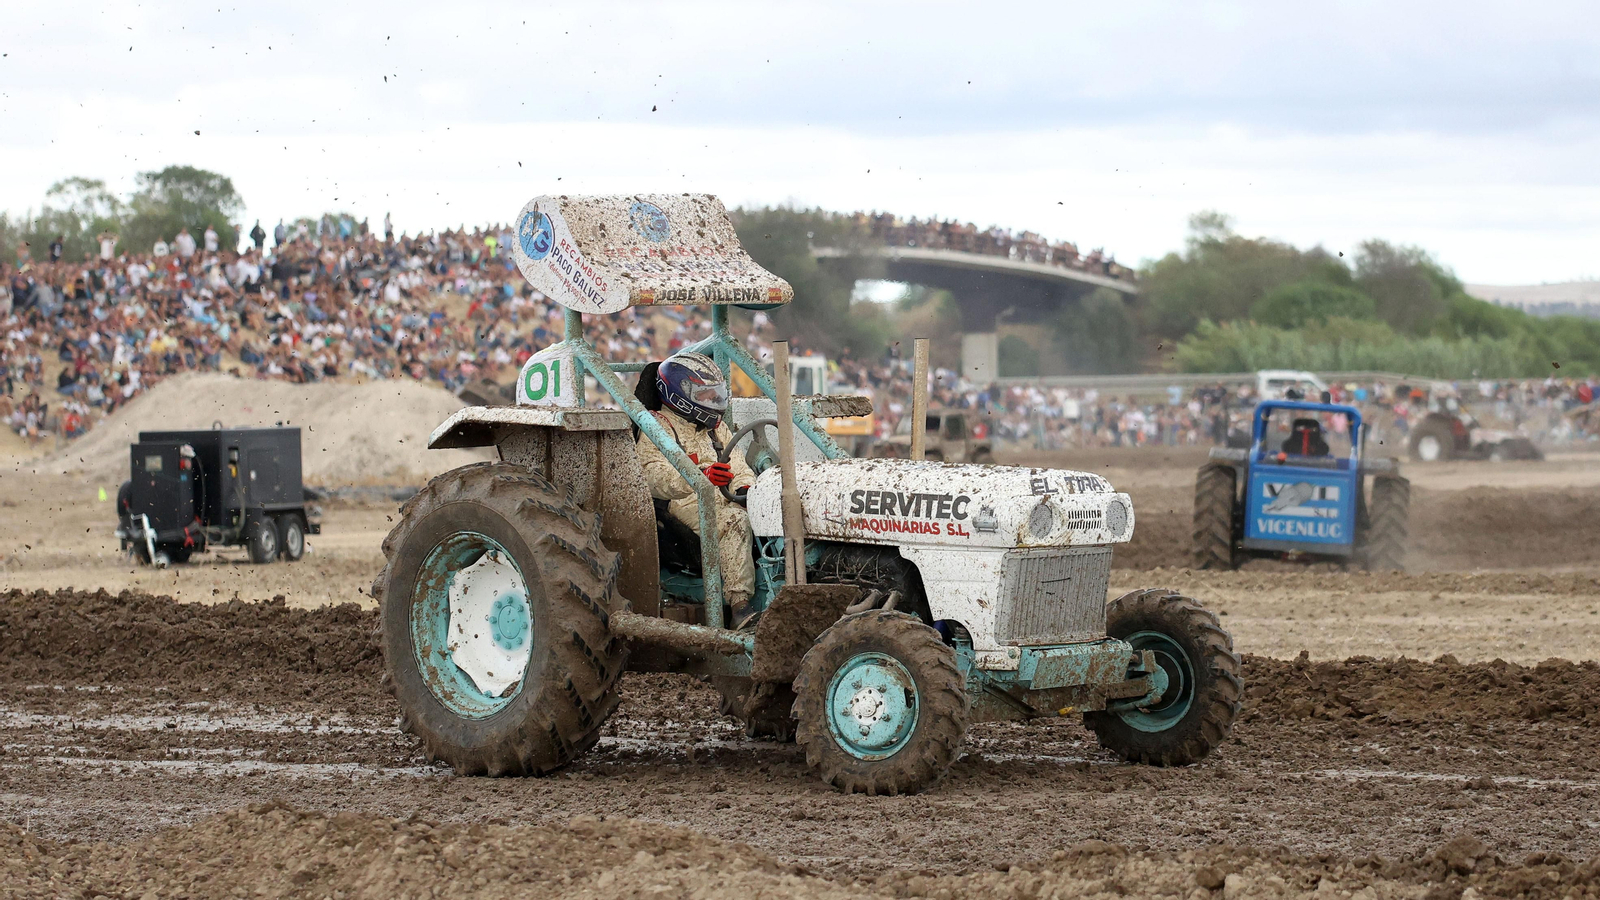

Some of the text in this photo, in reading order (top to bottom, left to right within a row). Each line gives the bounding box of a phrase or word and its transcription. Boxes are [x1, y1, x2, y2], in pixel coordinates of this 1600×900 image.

[551, 246, 606, 309] PACO GALVEZ
[560, 238, 608, 292] RECAMBIOS
[702, 287, 761, 302] VILLENA
[524, 359, 561, 401] 01
[1029, 477, 1058, 496] EL
[849, 489, 972, 521] SERVITEC
[849, 518, 941, 536] MAQUINARIAS
[1257, 518, 1342, 538] VICENLUC
